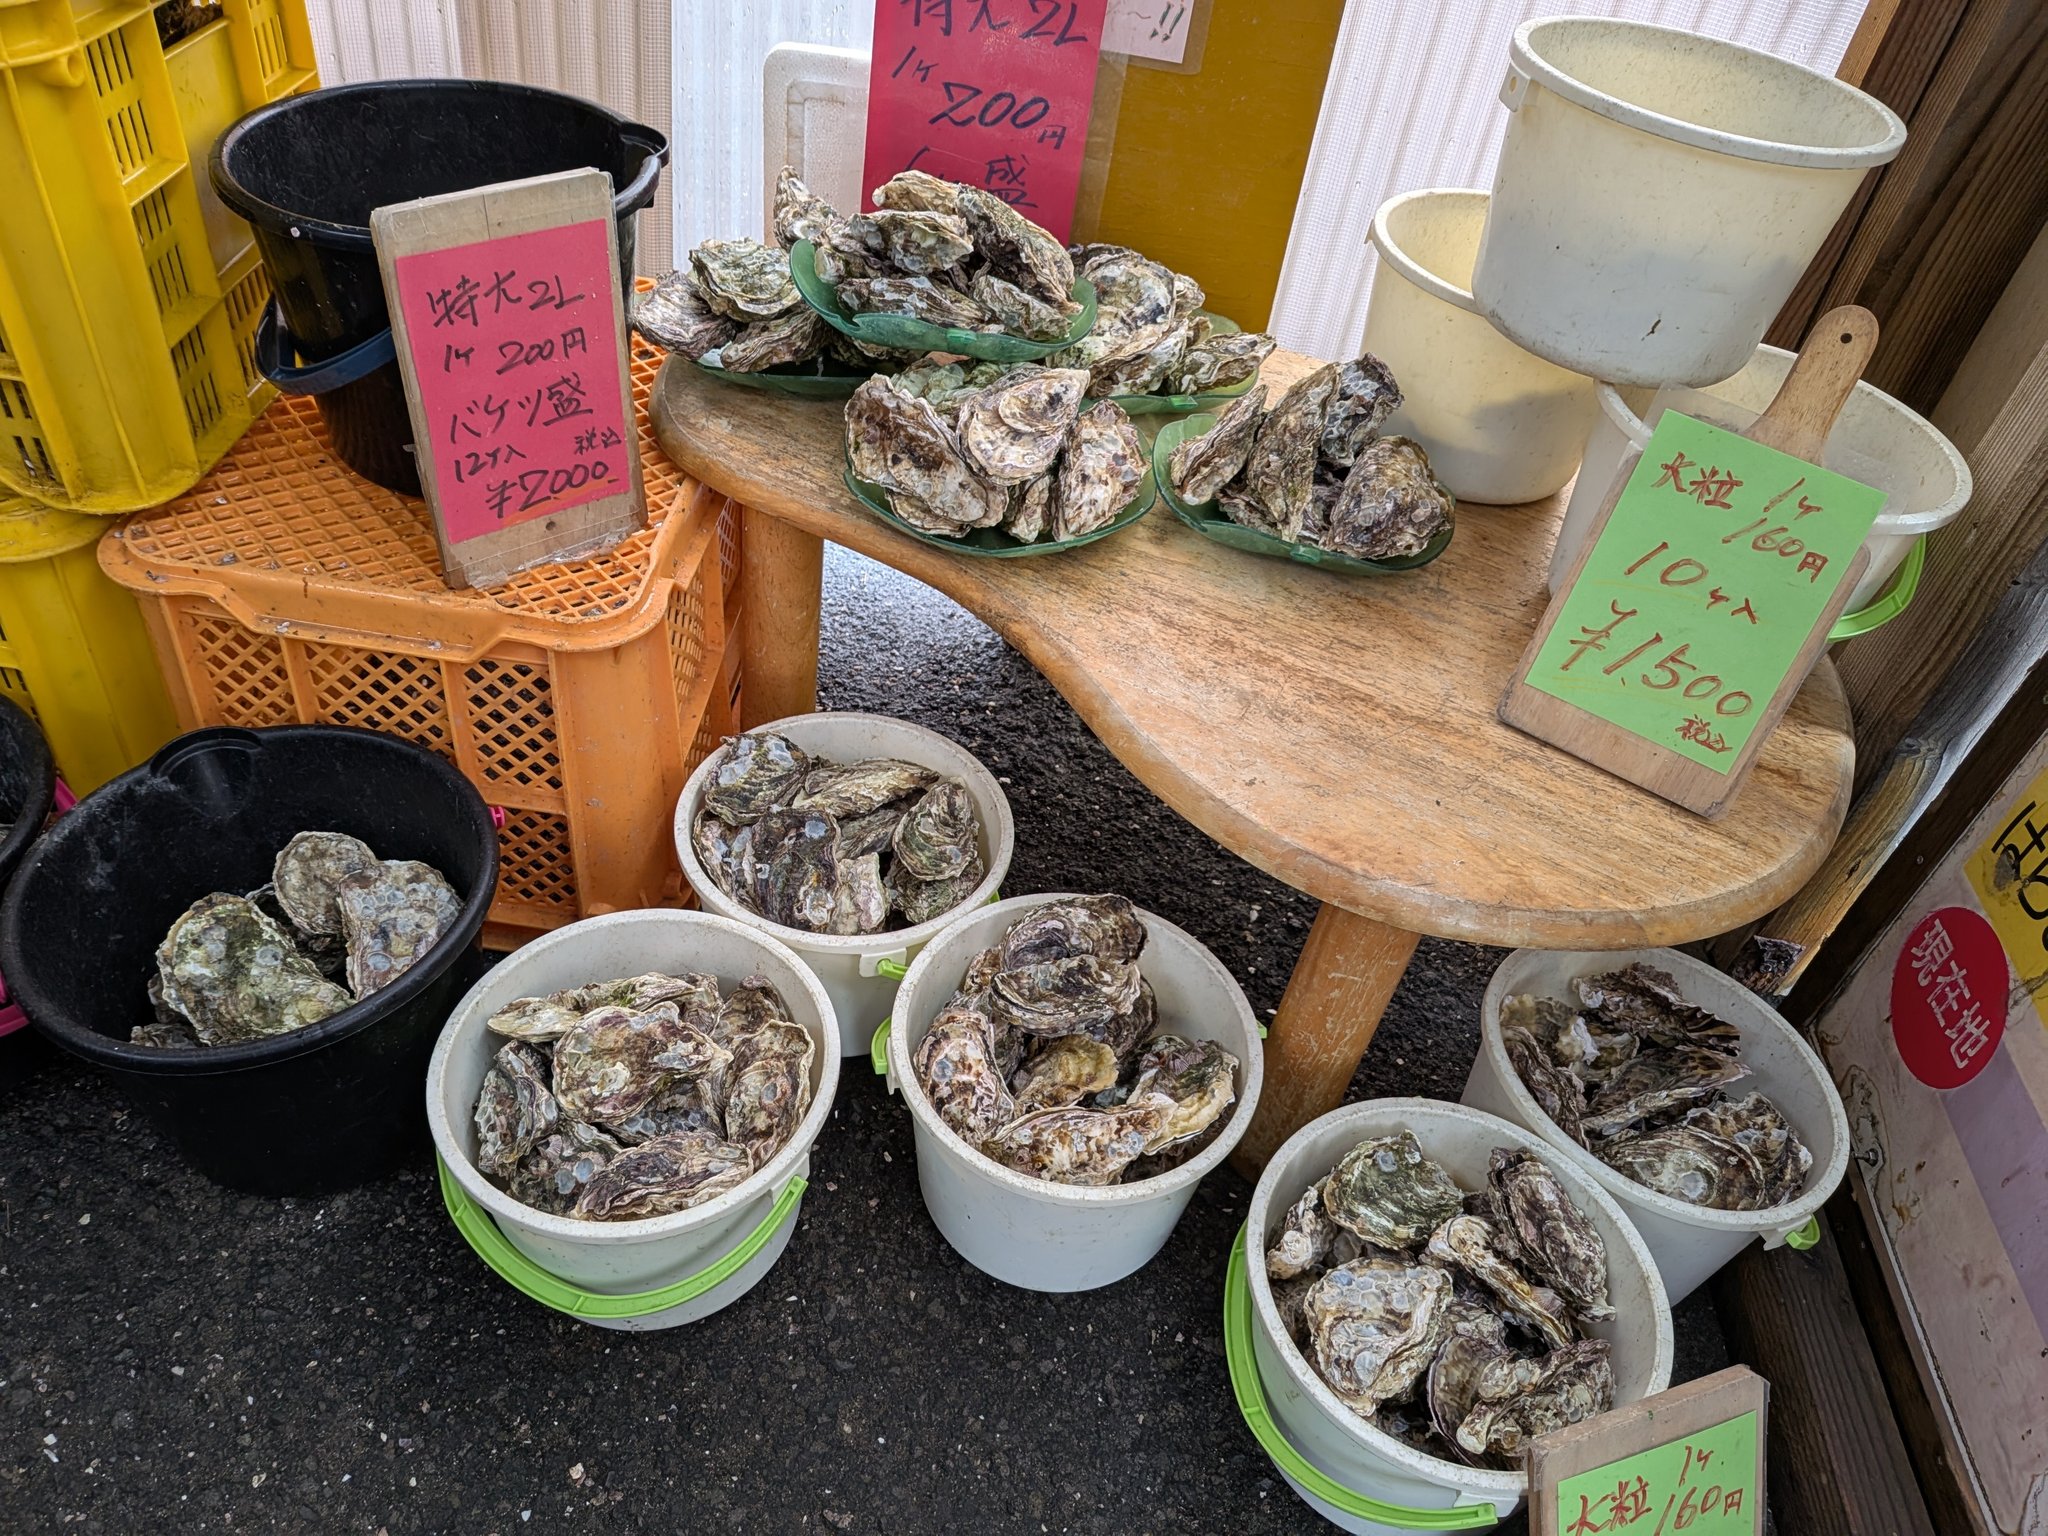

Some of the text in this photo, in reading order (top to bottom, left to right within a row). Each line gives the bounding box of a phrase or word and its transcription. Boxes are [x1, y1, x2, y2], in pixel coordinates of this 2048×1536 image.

[497, 327, 587, 374] 200円
[449, 371, 594, 444] バケツ盛
[1721, 517, 1829, 584] 160円
[1911, 918, 1992, 1071] 現在地
